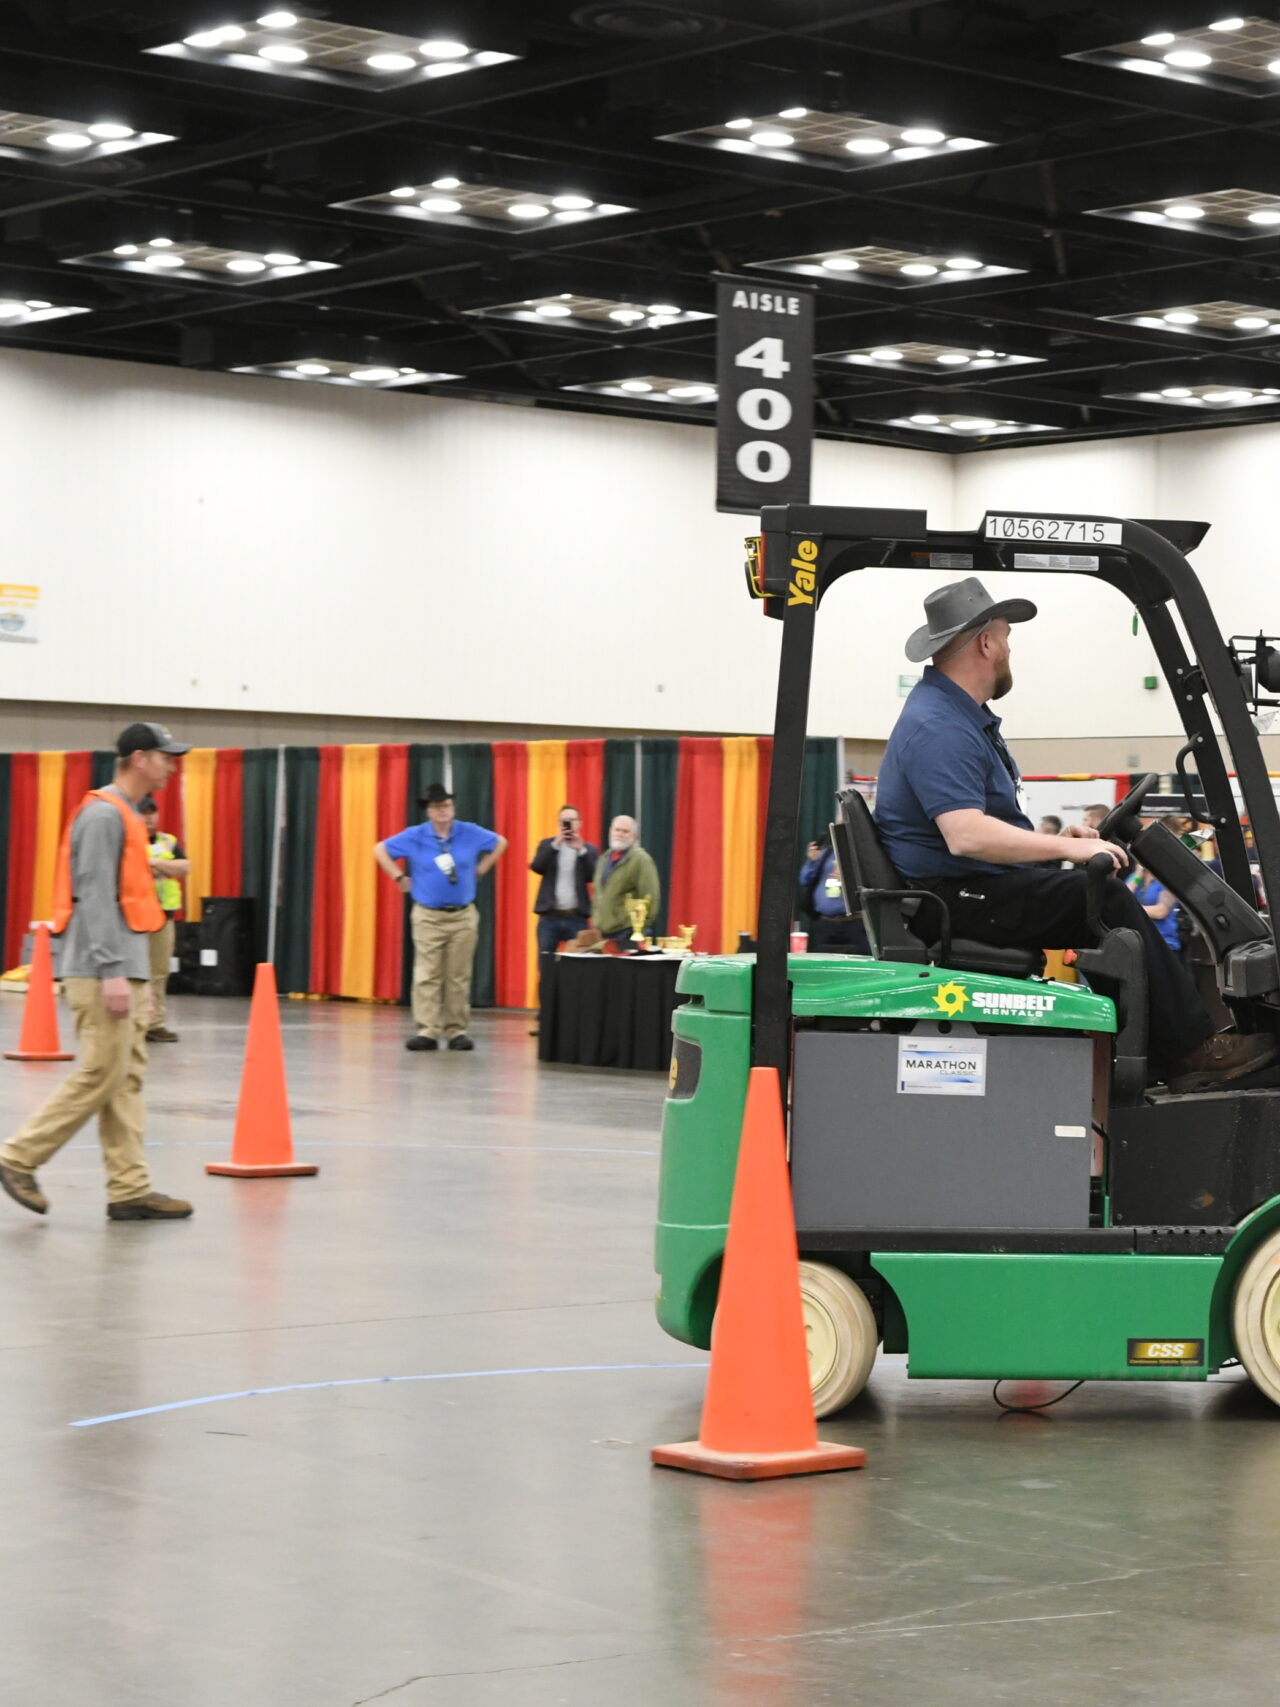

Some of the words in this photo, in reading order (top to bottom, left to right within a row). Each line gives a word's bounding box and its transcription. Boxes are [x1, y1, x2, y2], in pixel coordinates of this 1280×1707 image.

[731, 290, 800, 315] AISLE
[734, 336, 792, 483] 400
[989, 518, 1105, 542] 10562715
[787, 540, 818, 606] Yale
[971, 991, 1057, 1011] SUNBELT
[982, 1008, 1043, 1018] RENTALS
[905, 1059, 977, 1070] MARATHON
[939, 1069, 977, 1077] CLASSIC
[1147, 1343, 1185, 1358] CSS
